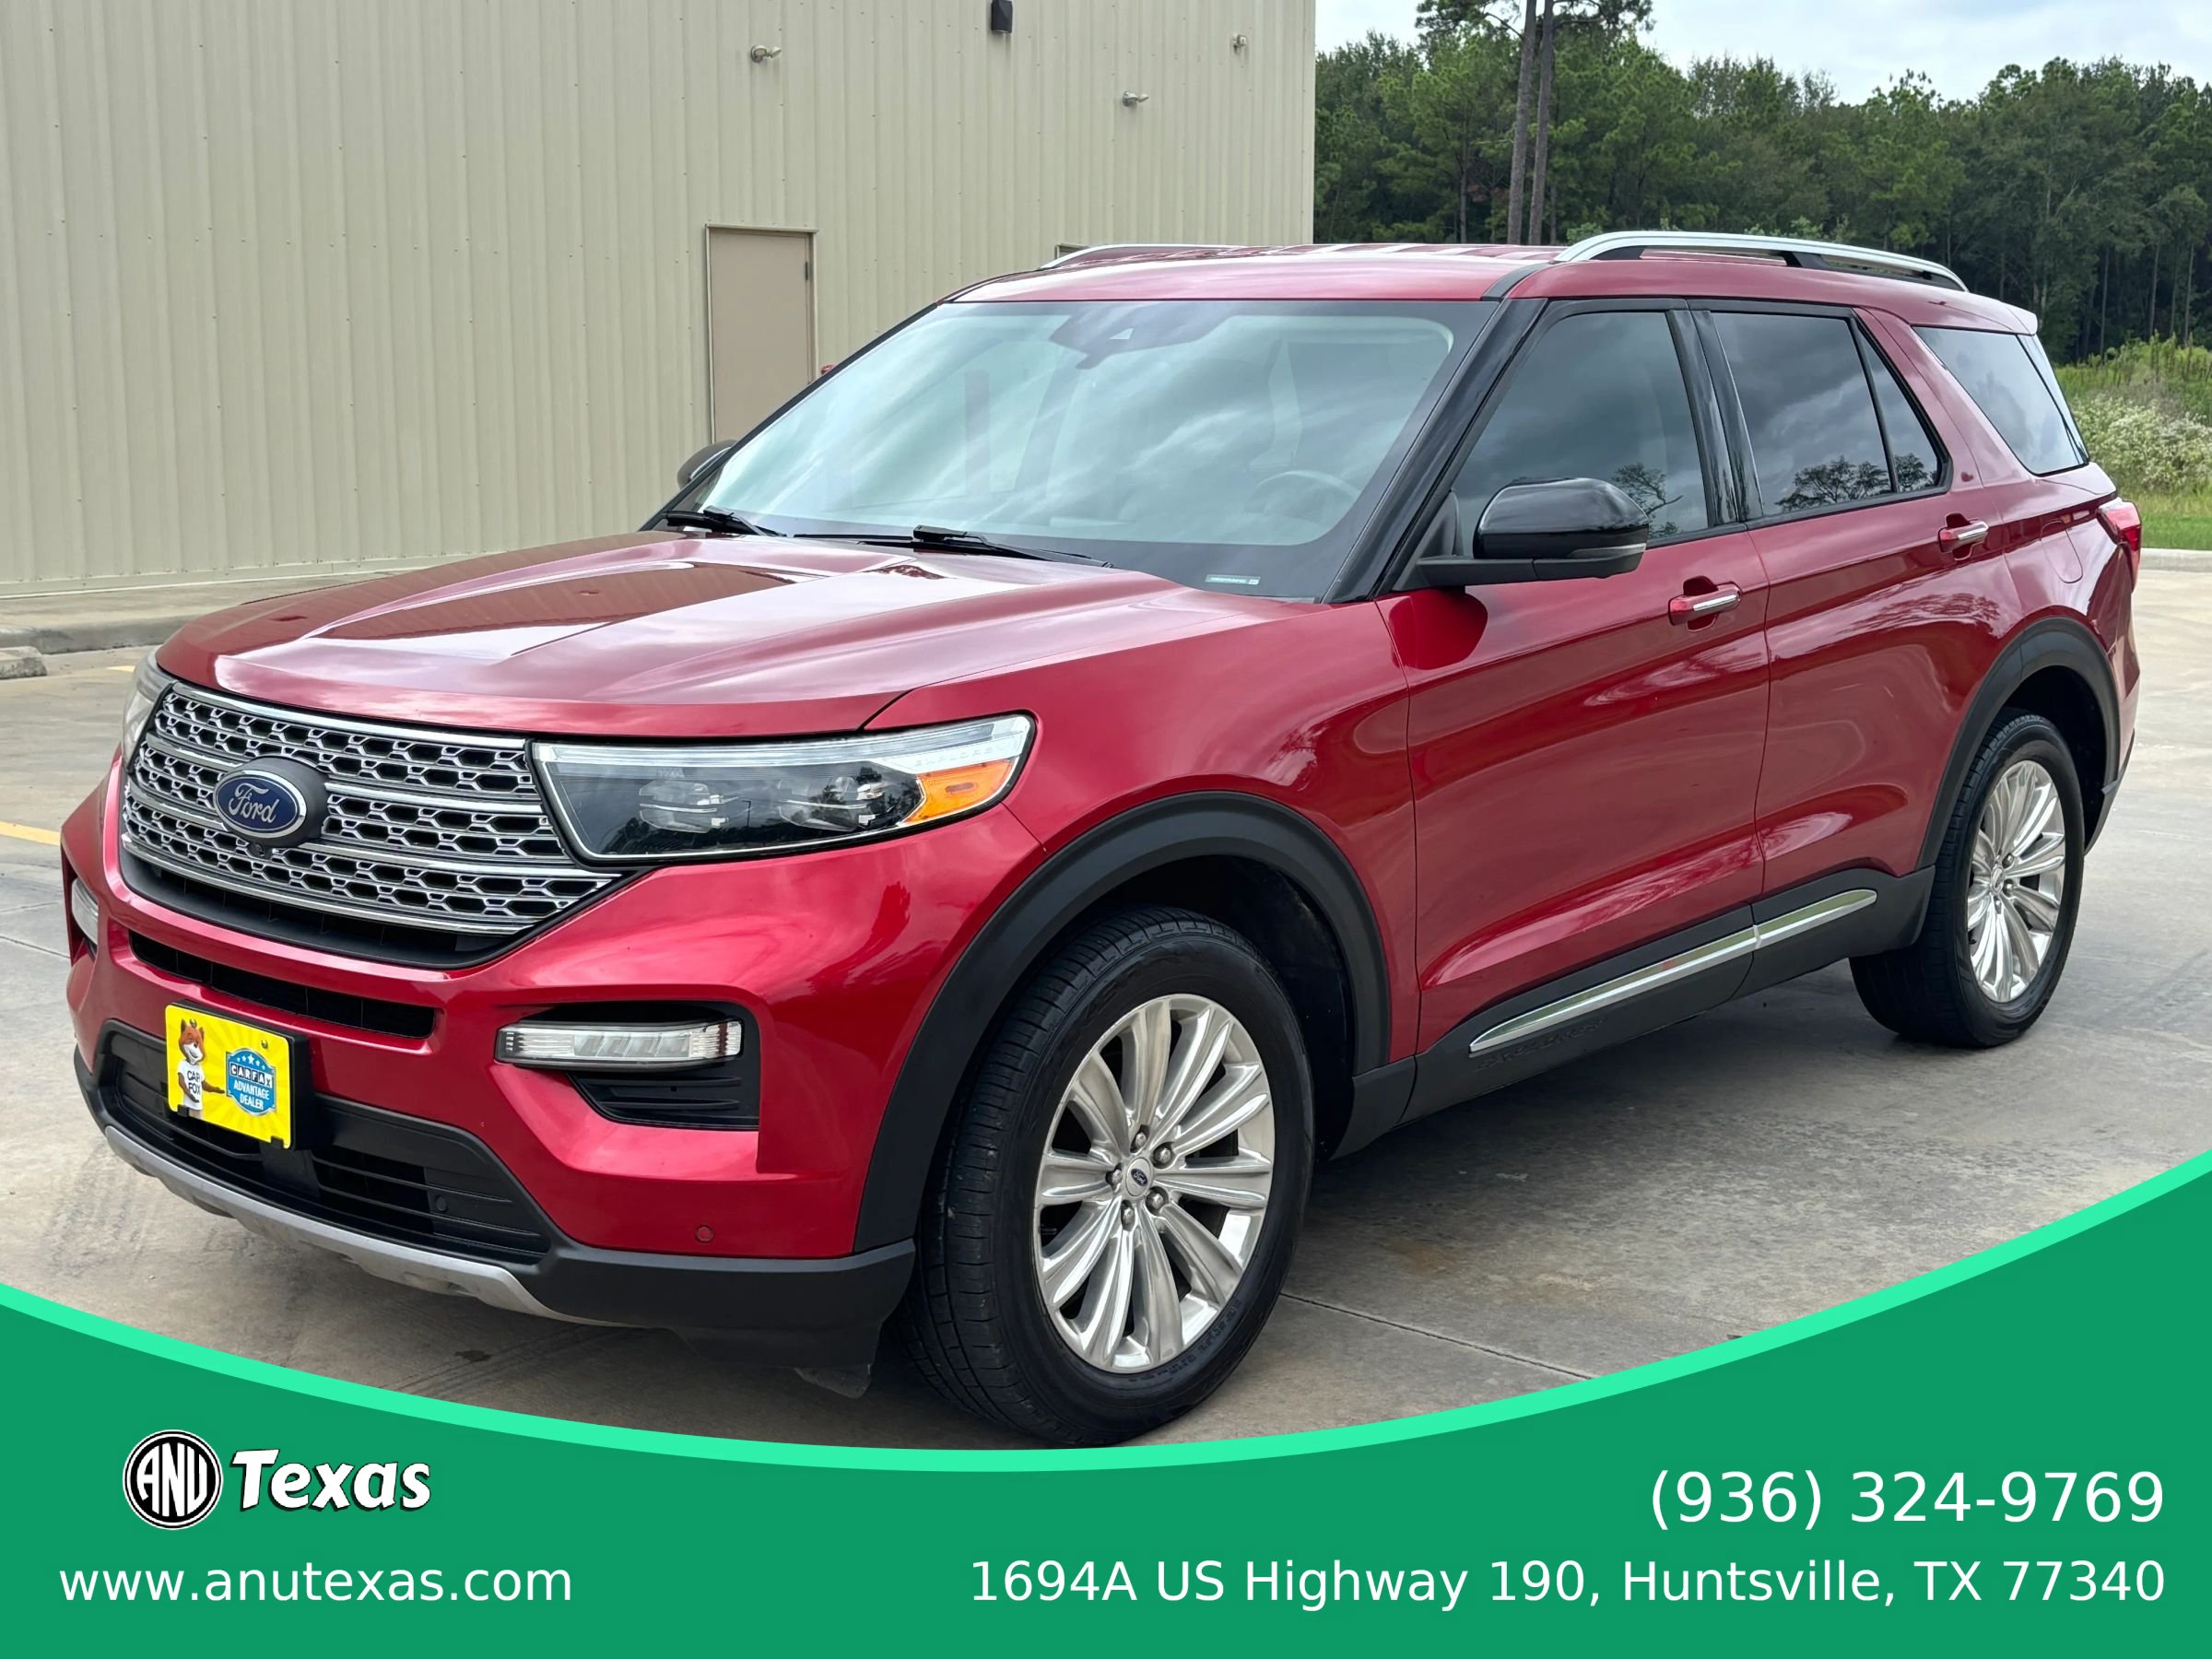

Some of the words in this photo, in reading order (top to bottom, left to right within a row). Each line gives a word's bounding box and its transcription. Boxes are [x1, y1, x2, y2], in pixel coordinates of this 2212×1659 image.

[229, 782, 280, 824] Ford
[187, 1070, 200, 1082] CAR
[230, 1064, 273, 1088] CARFAX
[188, 1082, 200, 1095] FOX
[233, 1079, 270, 1100] ADVANTAGE
[240, 1093, 264, 1111] DEALER
